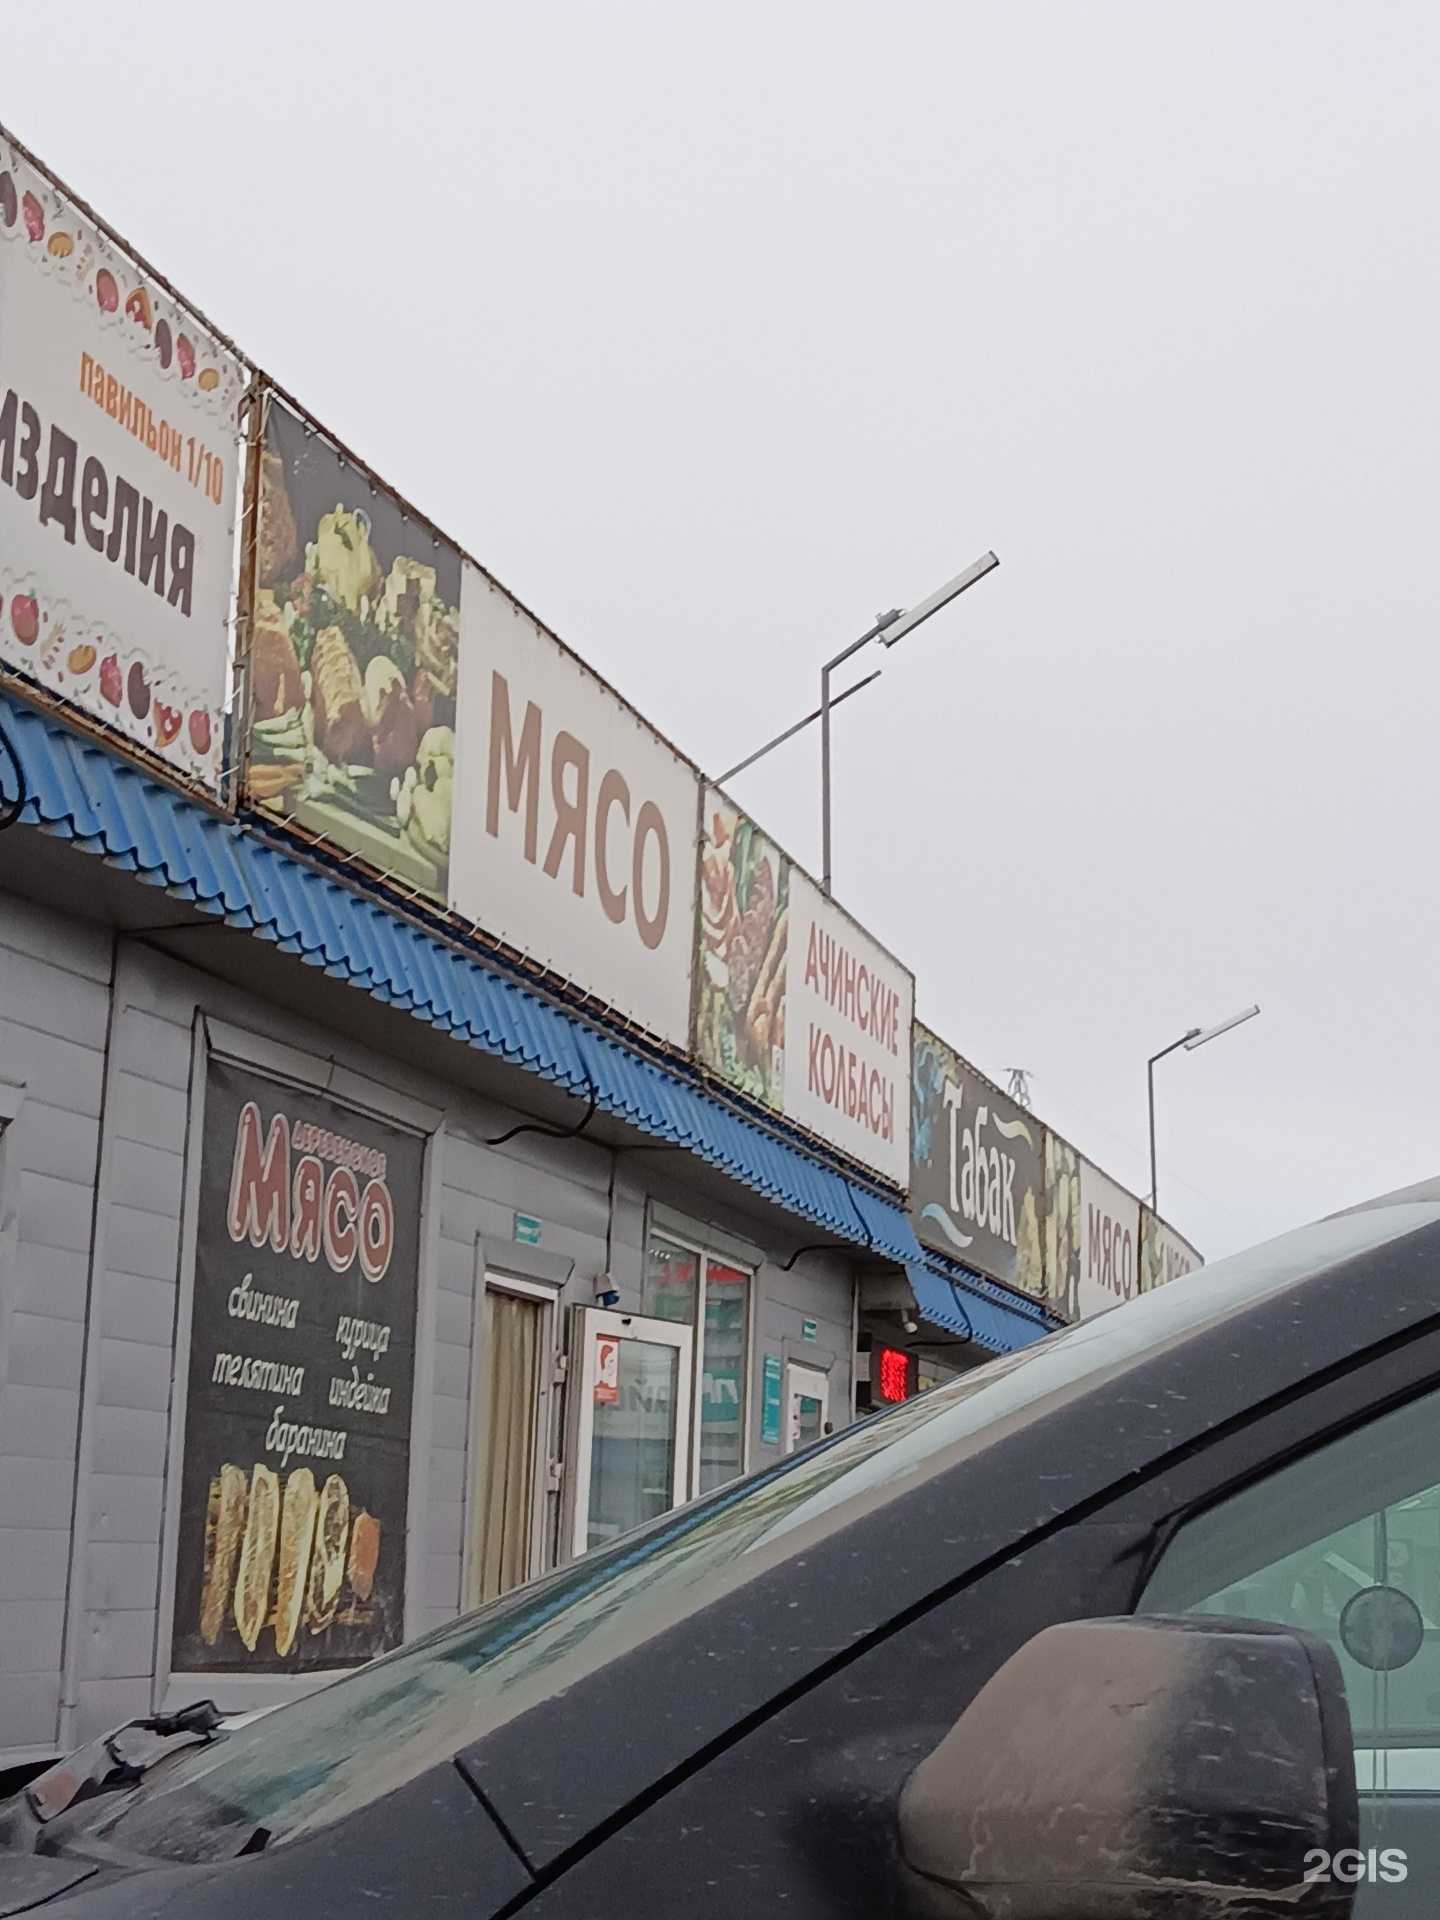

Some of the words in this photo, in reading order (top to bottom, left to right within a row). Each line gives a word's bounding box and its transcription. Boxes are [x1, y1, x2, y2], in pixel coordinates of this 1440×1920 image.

[80, 351, 183, 473] павильон
[187, 436, 225, 505] 1/10
[486, 669, 671, 950] МЯСО
[805, 921, 899, 1056] АЧИНСКИЕ
[808, 1022, 894, 1144] КОЛБАСЫ
[942, 1078, 1017, 1247] Табак
[227, 1272, 300, 1329] свинина
[1087, 1202, 1132, 1301] МЯСО
[211, 1352, 305, 1397] телятина
[336, 1315, 391, 1362] курица
[265, 1404, 348, 1469] баранина
[328, 1365, 392, 1415] индейка
